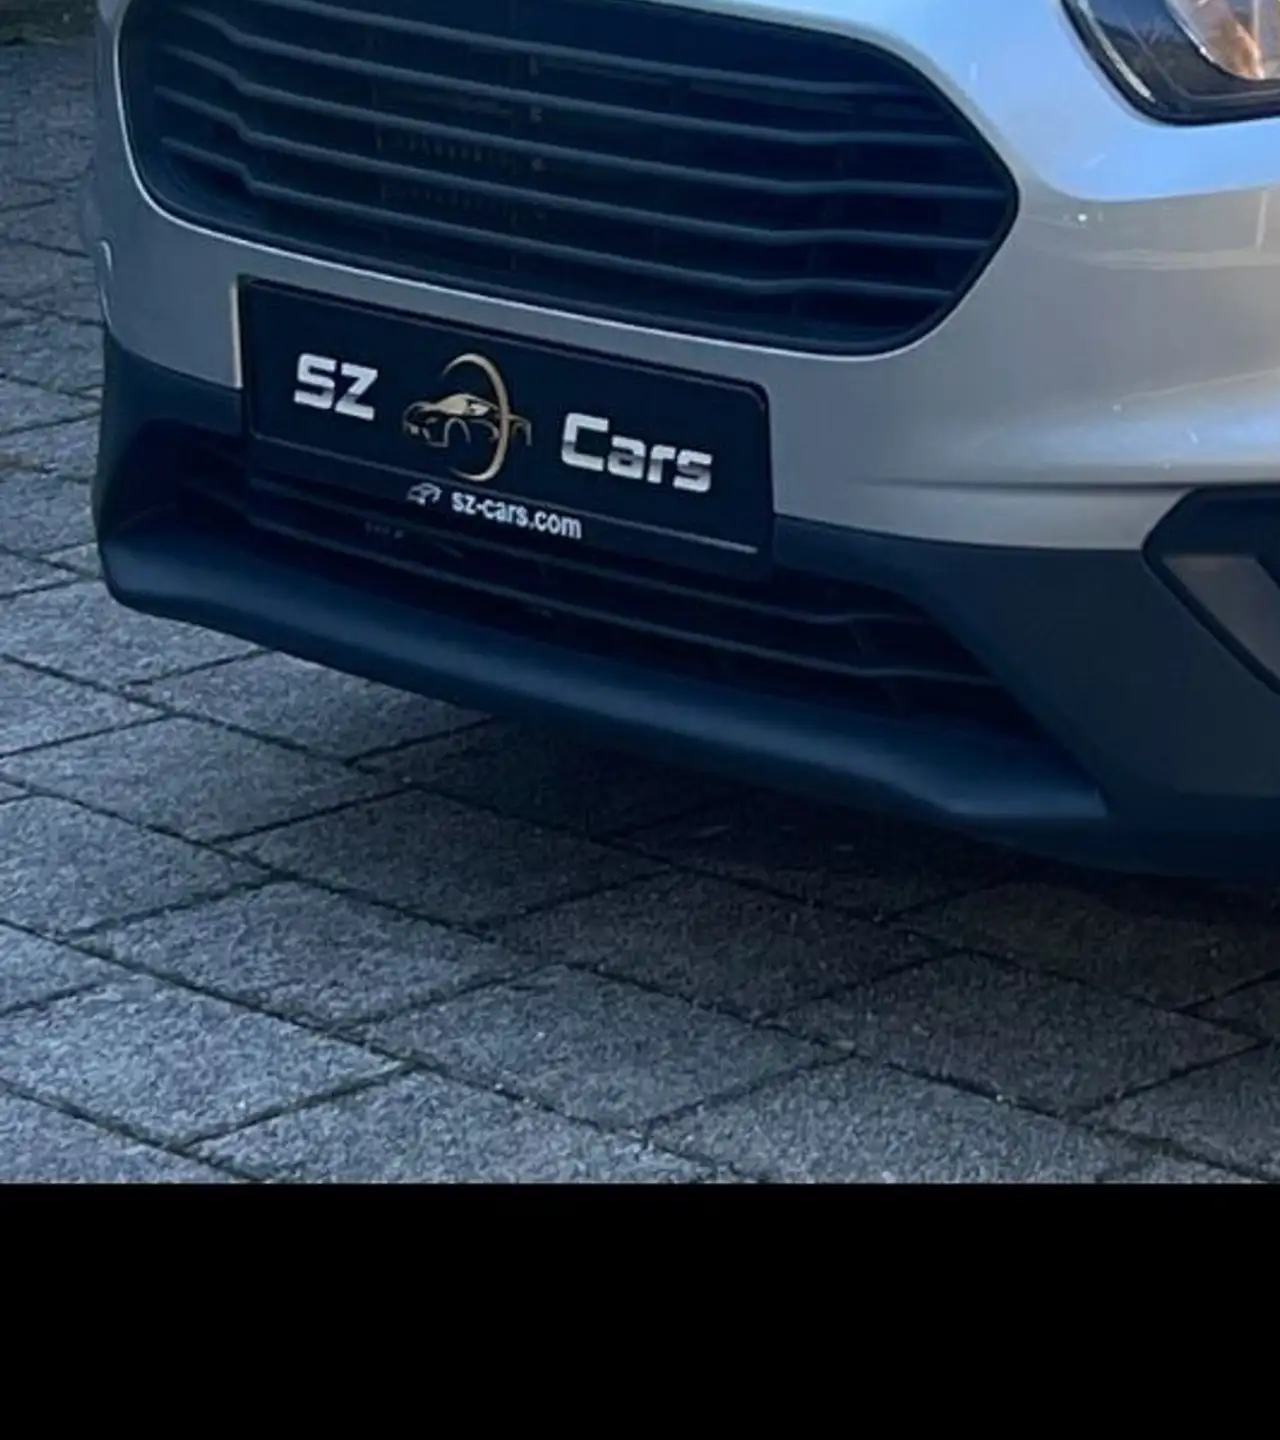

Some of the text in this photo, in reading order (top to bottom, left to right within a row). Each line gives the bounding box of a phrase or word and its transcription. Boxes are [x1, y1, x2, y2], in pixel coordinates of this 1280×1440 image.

[293, 353, 713, 492] SZ Cars
[452, 490, 583, 539] sz-cars.com
